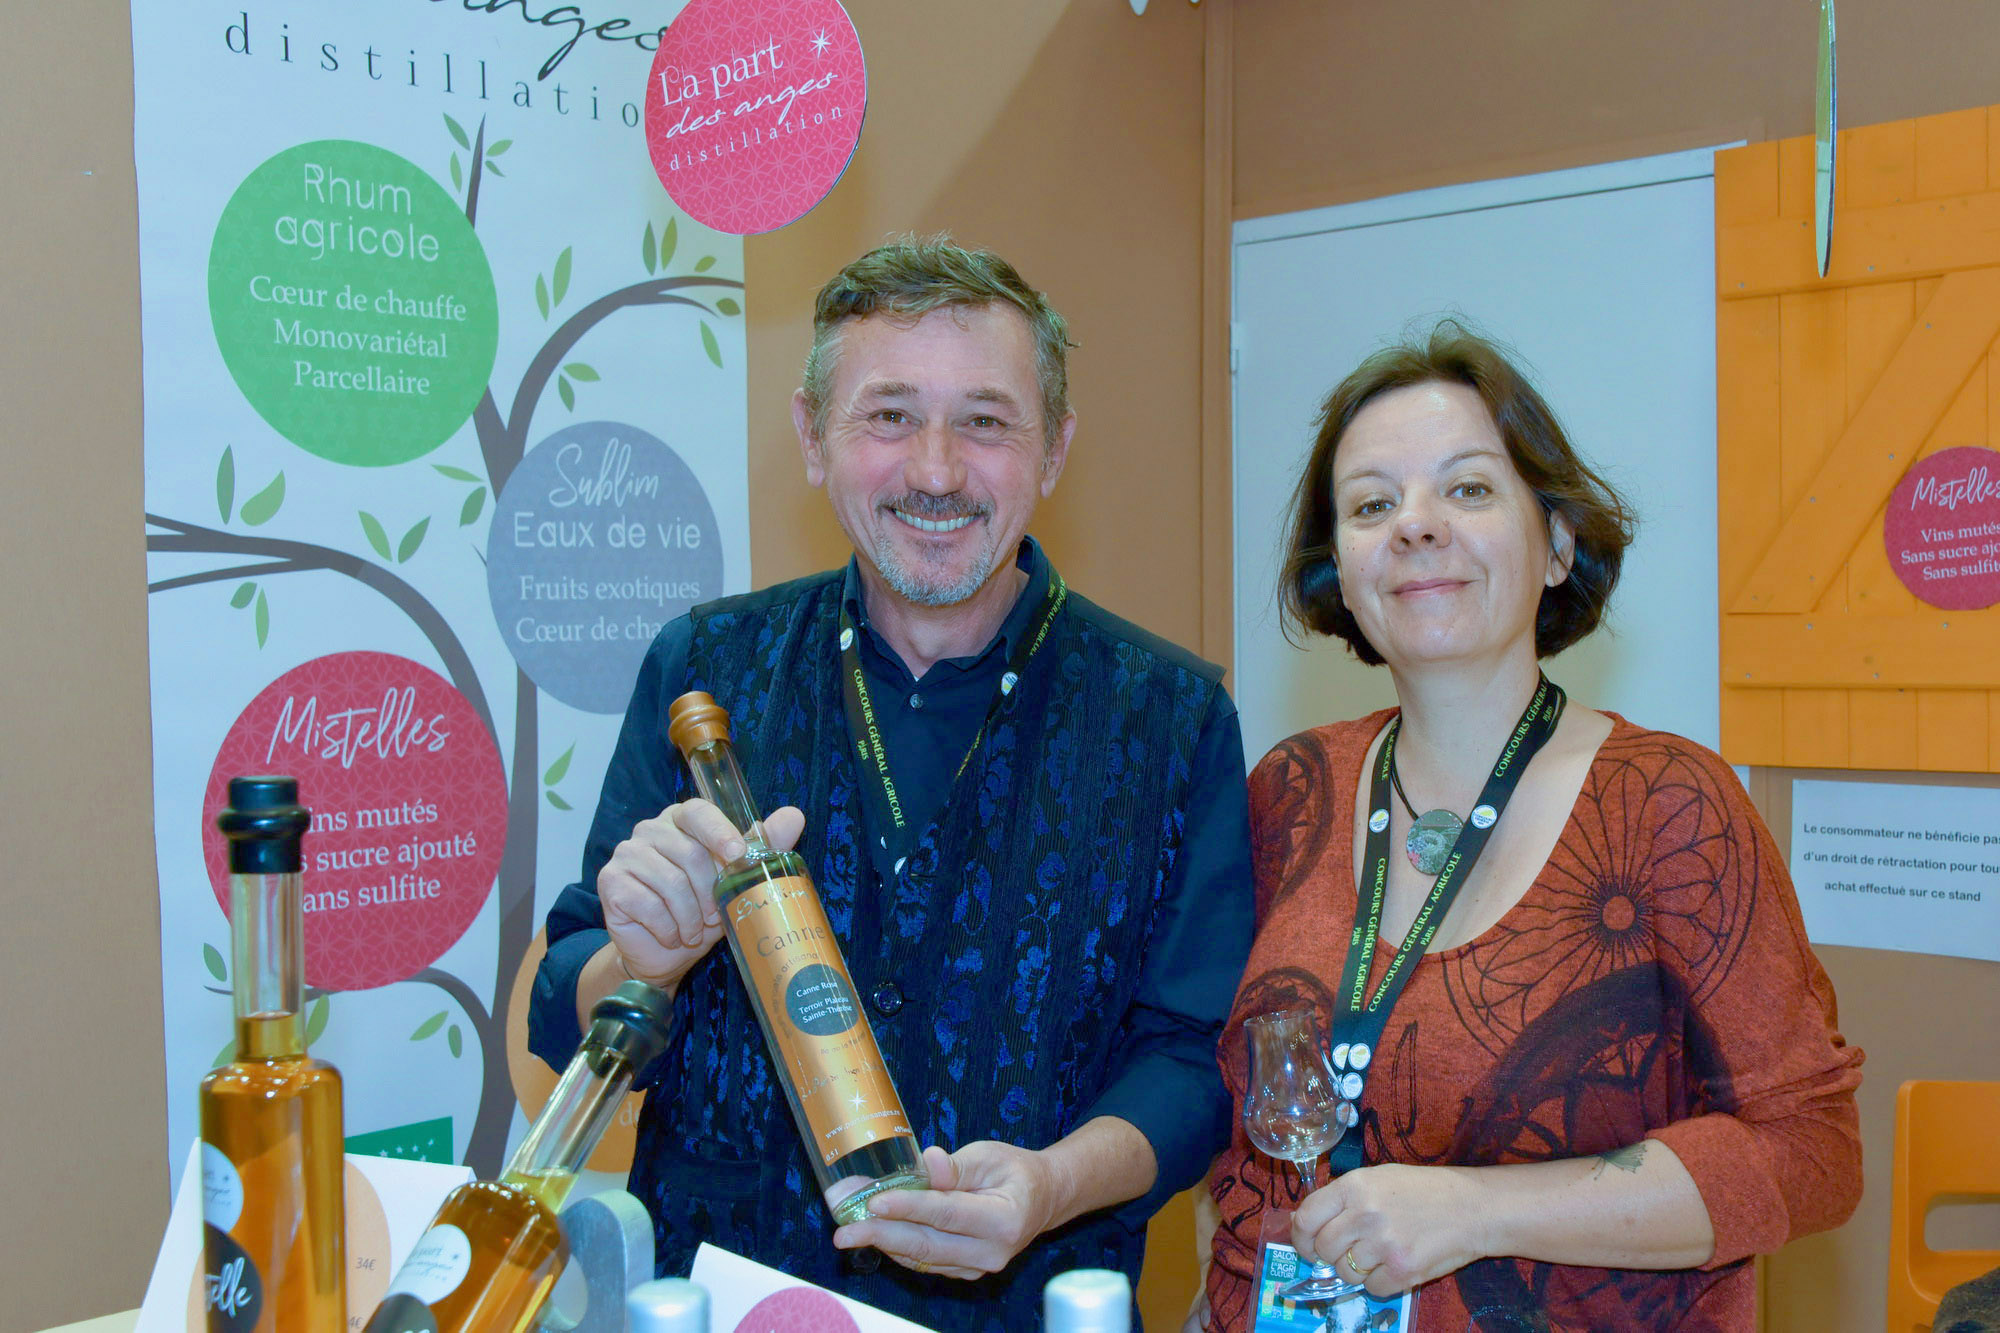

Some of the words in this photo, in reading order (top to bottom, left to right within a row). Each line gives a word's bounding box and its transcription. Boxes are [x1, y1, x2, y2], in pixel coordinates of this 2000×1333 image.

[225, 11, 638, 127] distillatio
[658, 65, 702, 107] La
[709, 32, 784, 100] part
[666, 106, 726, 139] des
[734, 72, 838, 125] anges
[670, 106, 842, 171] distillation
[304, 163, 411, 215] Rhum
[275, 216, 439, 262] agricole
[249, 275, 327, 307] Cœur
[336, 285, 367, 311] de
[374, 289, 467, 321] chauffe
[274, 318, 448, 358] Monovariétal
[294, 360, 430, 395] Parcellaire
[549, 437, 659, 508] Sublim
[514, 512, 595, 549] Eaux
[608, 515, 646, 549] de
[657, 517, 701, 549] vie
[1921, 528, 1954, 543] Vins
[1901, 549, 1935, 565] Sans
[1938, 545, 1978, 560] sucre
[1923, 566, 1958, 581] Sans
[520, 575, 588, 600] Fruits
[595, 577, 700, 607] exotiques
[516, 617, 584, 643] Cœur
[591, 616, 619, 641] de
[625, 615, 661, 639] cha
[266, 686, 450, 769] Mistelles
[854, 668, 875, 725] CONCOURS
[882, 775, 905, 829] AGRICOLE
[1495, 721, 1530, 778] CONCOURS
[308, 807, 348, 834] ins
[357, 798, 438, 829] mutés
[1803, 823, 1817, 834] Le
[1820, 826, 1904, 839] consommateur
[1907, 830, 1922, 840] ne
[1925, 830, 1980, 844] bénéficie
[1983, 835, 2000, 846] pa
[317, 844, 389, 872] sucre
[397, 831, 476, 872] ajouté
[1803, 851, 1828, 863] d'un
[1831, 853, 1857, 865] droit
[1860, 855, 1874, 866] de
[1877, 856, 1947, 871] rétractation
[1950, 862, 1977, 874] pour
[303, 889, 350, 913] ans
[358, 874, 441, 908] sulfite
[1371, 857, 1386, 915] CONCOURS
[1824, 880, 1856, 893] achat
[1859, 883, 1906, 896] effectué
[1909, 888, 1928, 898] sur
[1931, 889, 1946, 899] ce
[1948, 890, 1981, 902] stand
[757, 926, 826, 958] Canne
[1368, 954, 1406, 1013] CONCOURS
[1430, 851, 1463, 903] AGRICOLE
[796, 985, 820, 998] Canne
[1351, 962, 1367, 1012] AGRICOLE
[799, 1001, 823, 1014] Terroir
[355, 1257, 377, 1271] 34€
[1272, 1250, 1298, 1261] SALON
